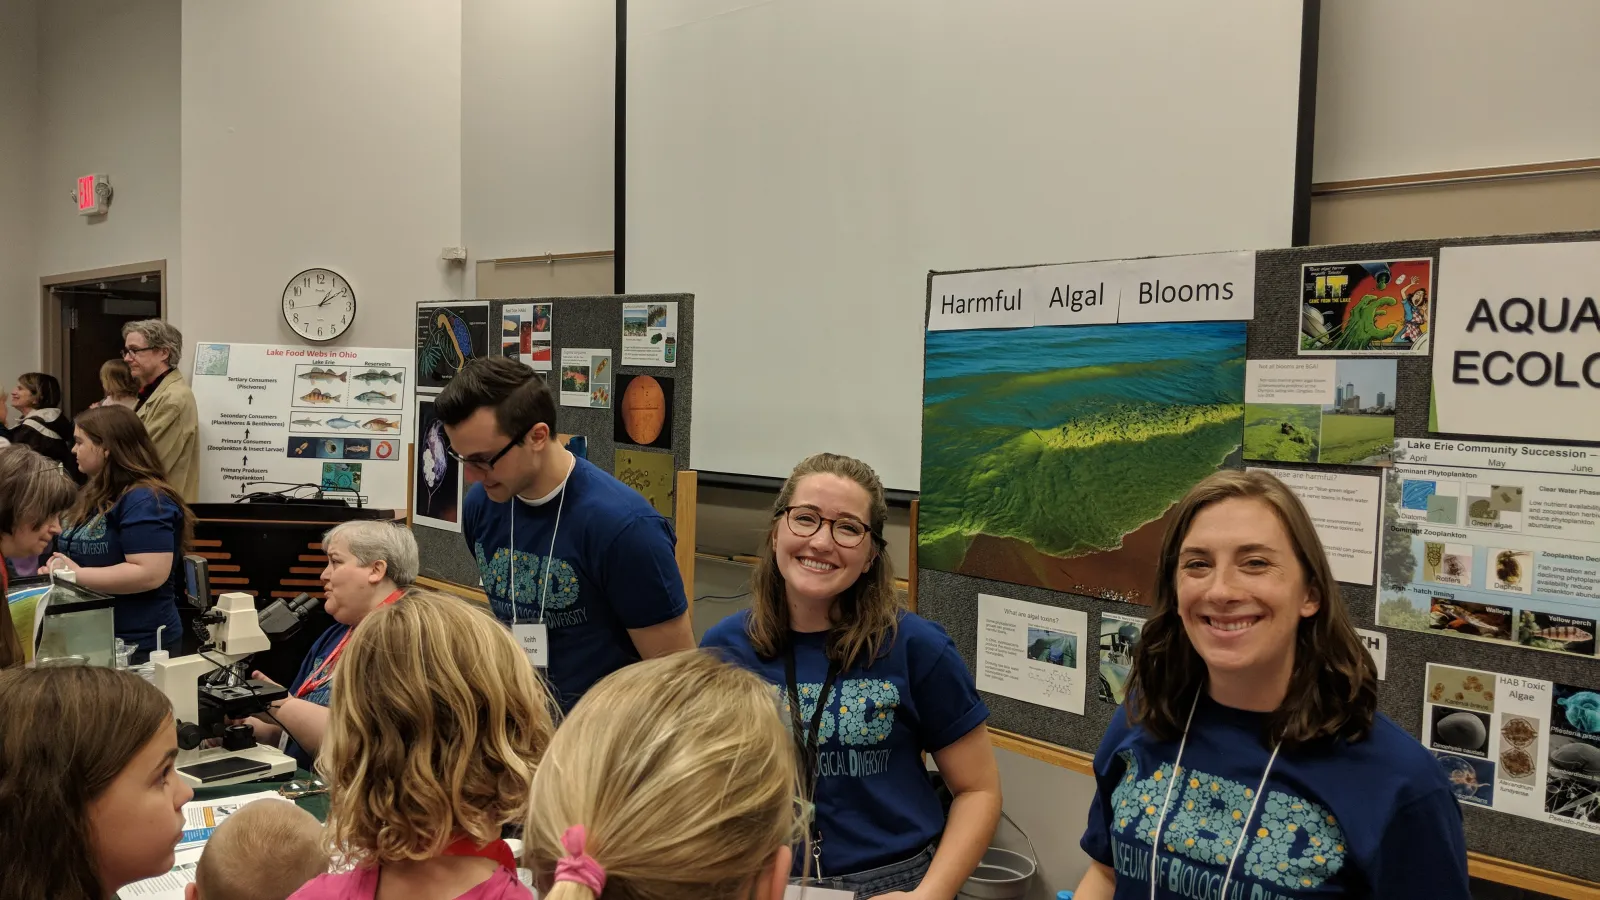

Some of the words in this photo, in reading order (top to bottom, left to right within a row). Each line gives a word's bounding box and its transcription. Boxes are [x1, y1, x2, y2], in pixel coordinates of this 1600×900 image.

[79, 175, 94, 209] EXIT
[1316, 275, 1348, 298] IT
[941, 288, 1022, 315] Harmful
[1048, 282, 1104, 312] Algal
[1138, 280, 1234, 305] Blooms
[1407, 441, 1431, 450] Lake
[1434, 442, 1454, 451] Erie
[1457, 443, 1518, 456] Community
[1521, 446, 1586, 459] Succession
[1410, 454, 1427, 462] April
[1488, 459, 1506, 468] May
[1571, 464, 1593, 473] June
[1305, 472, 1338, 481] harmful?
[1394, 467, 1426, 475] Dominant
[1428, 470, 1477, 479] Phytoplankton
[1401, 513, 1427, 521] Diatoms
[1551, 516, 1595, 525] phytoplankton
[1390, 525, 1422, 536] Dominant
[1424, 529, 1467, 539] Zooplankton
[1542, 551, 1584, 561] Zooplankton
[1436, 575, 1461, 583] Rotifers
[1537, 572, 1565, 580] declining
[1494, 582, 1523, 592] Daphnia
[1537, 580, 1569, 588] availability
[1434, 590, 1455, 599] timing
[1537, 587, 1574, 596] zooplankton
[1004, 608, 1017, 616] What
[1040, 615, 1059, 623] toxins?
[1486, 606, 1511, 616] Walleye
[545, 607, 588, 629] DIVERSITY
[1549, 615, 1570, 624] Yellow
[1572, 619, 1592, 627] perch
[1500, 677, 1519, 687] HAB
[1521, 680, 1546, 691] Toxic
[1509, 691, 1535, 702] Algae
[850, 749, 892, 777] DIVERSITY
